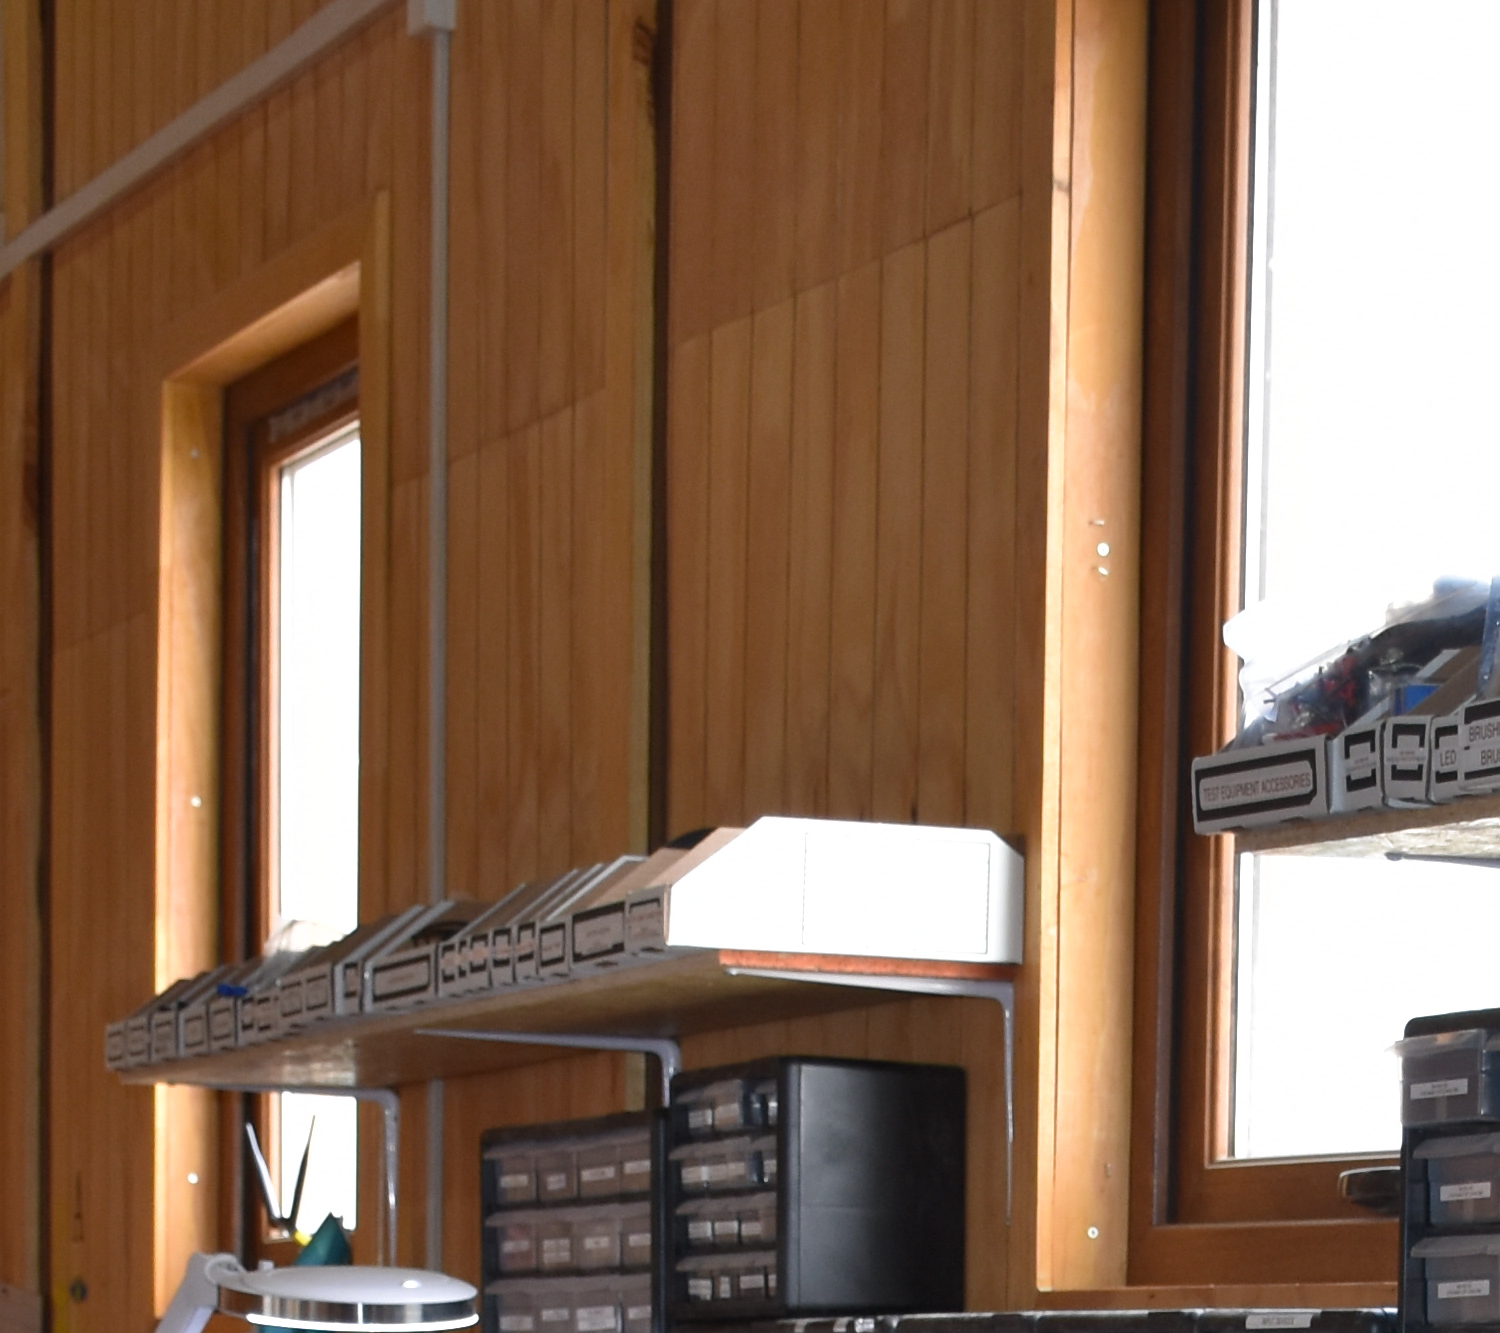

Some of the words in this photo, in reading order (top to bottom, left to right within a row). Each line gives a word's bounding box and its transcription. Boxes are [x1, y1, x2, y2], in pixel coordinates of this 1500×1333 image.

[1439, 750, 1457, 767] LED
[1203, 785, 1220, 802] TEST
[1260, 772, 1311, 792] ACCESSORIES
